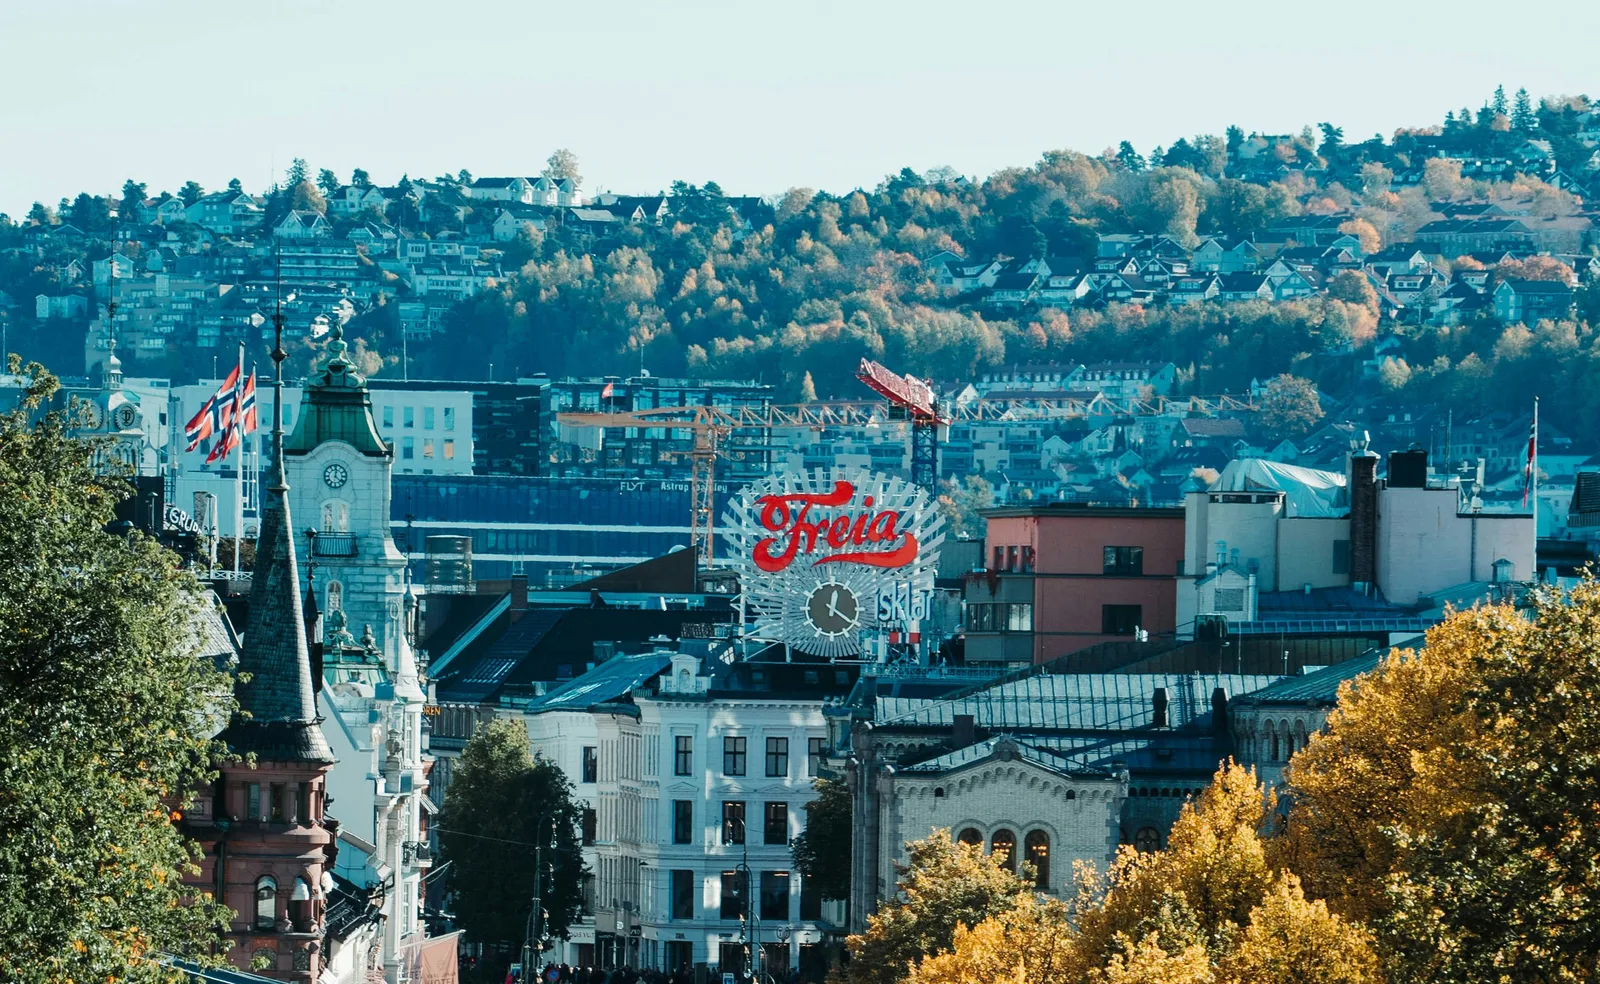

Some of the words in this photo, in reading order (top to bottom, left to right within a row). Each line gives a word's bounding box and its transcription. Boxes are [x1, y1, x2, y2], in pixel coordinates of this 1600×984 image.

[620, 482, 645, 491] FLYT
[661, 482, 689, 493] Astrup
[753, 480, 918, 572] Freia
